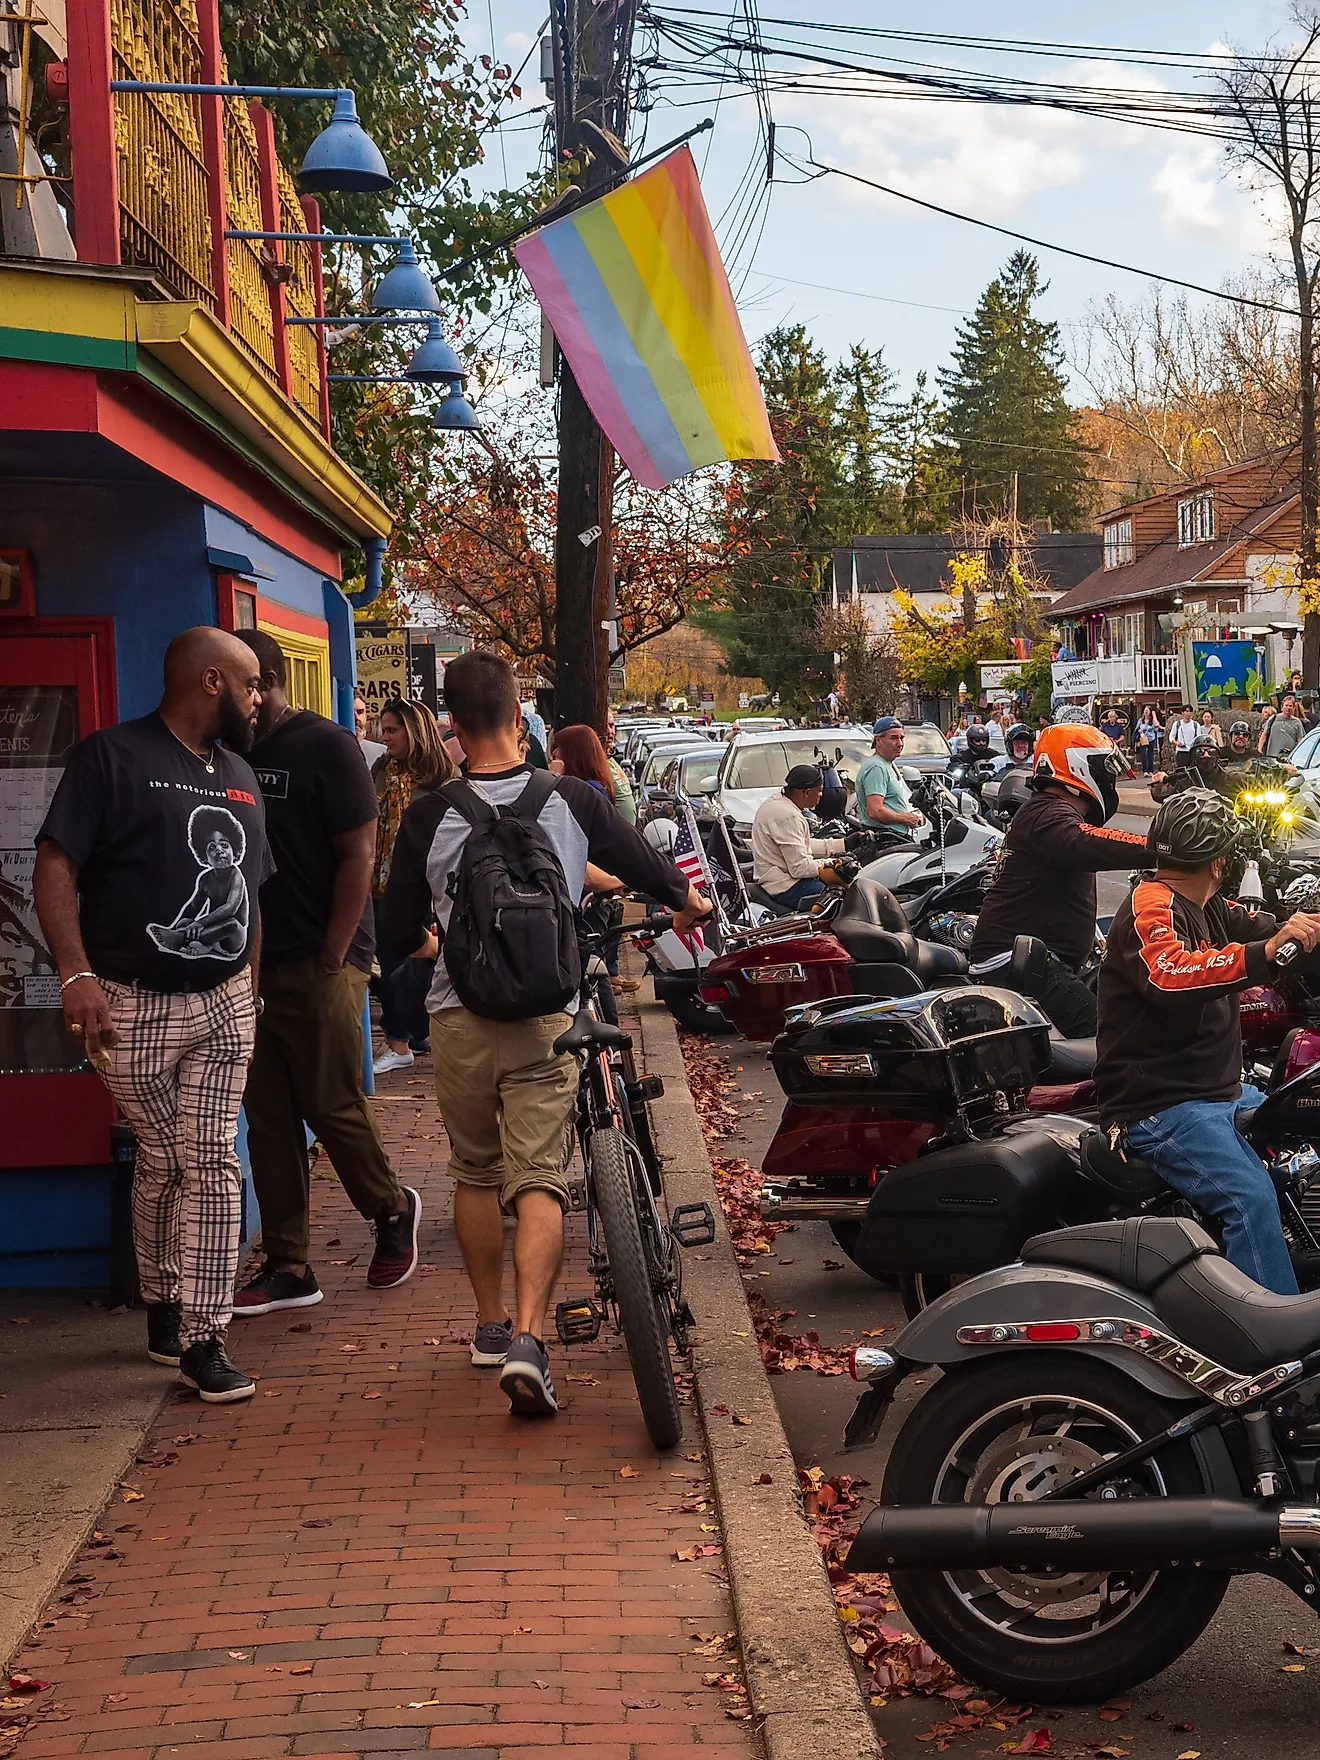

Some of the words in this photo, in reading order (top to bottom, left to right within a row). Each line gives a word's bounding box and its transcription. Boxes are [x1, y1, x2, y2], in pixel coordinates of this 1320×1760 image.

[366, 644, 405, 660] CIGARS
[175, 782, 227, 798] notorious
[1206, 952, 1235, 968] USA
